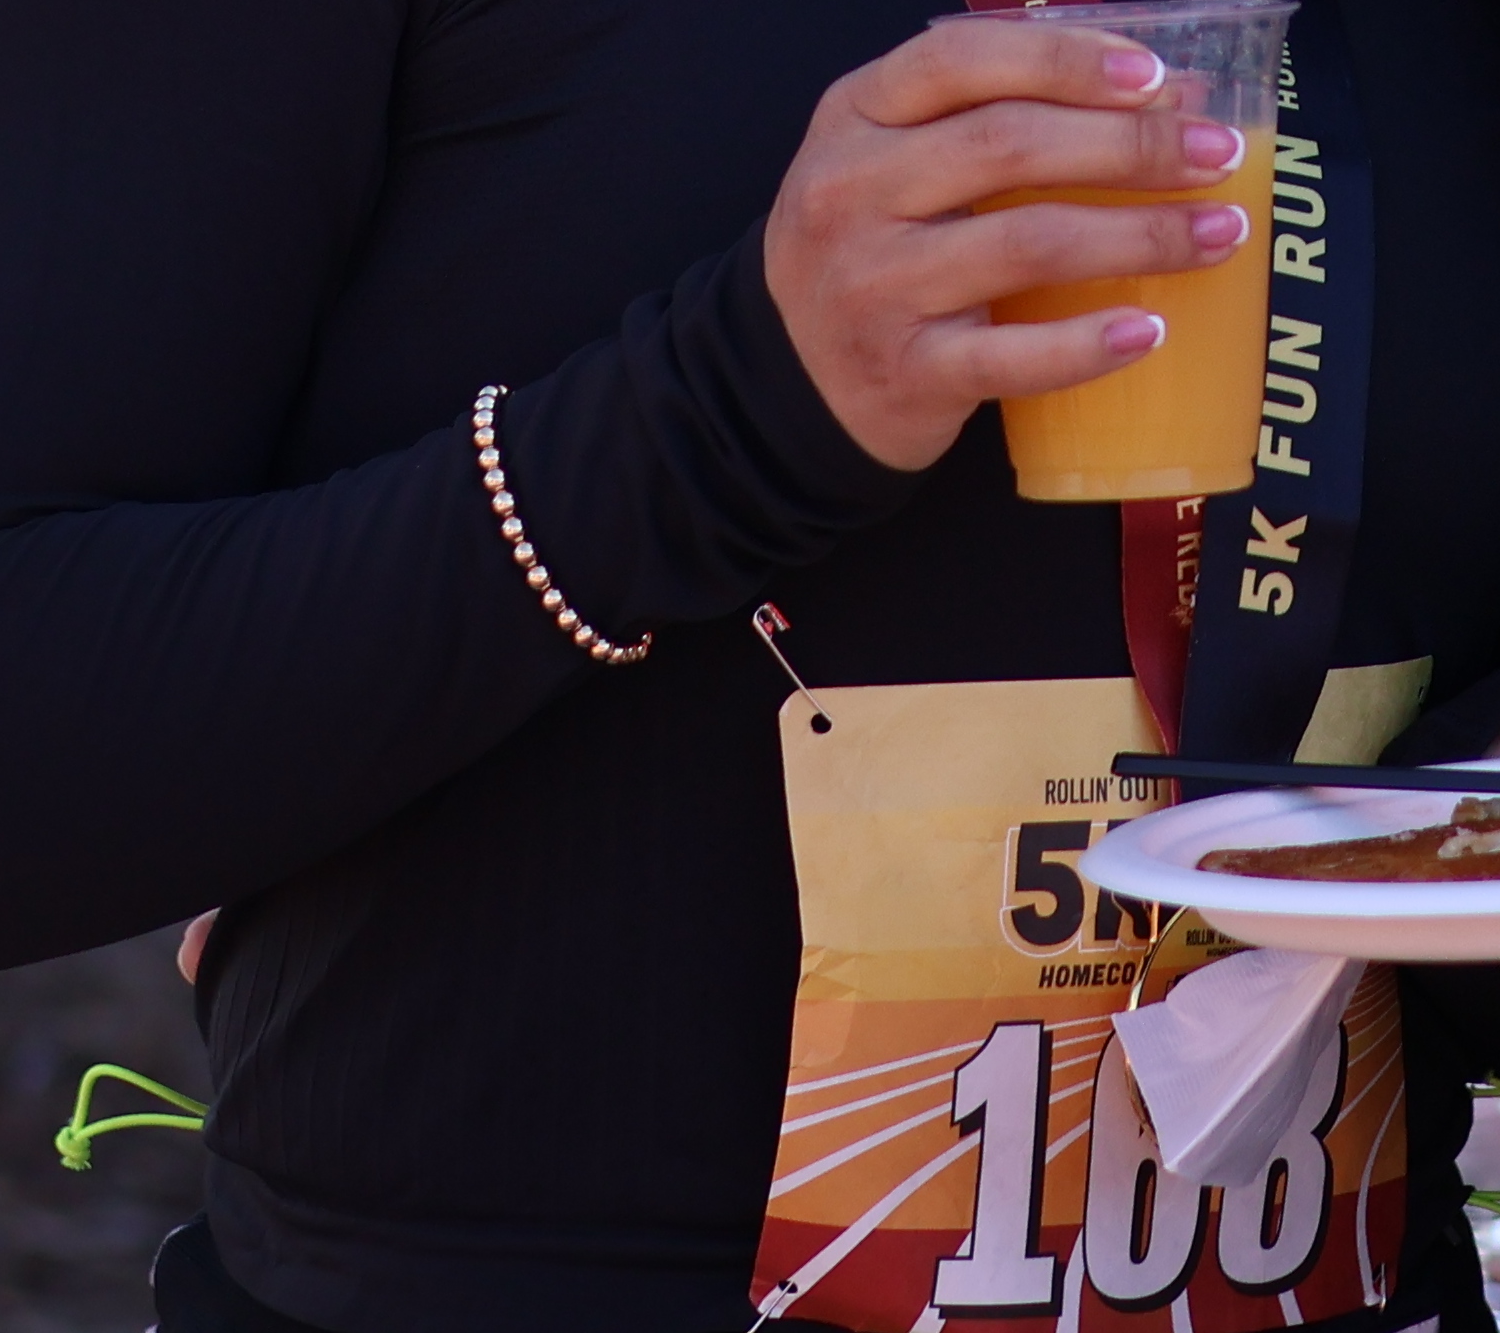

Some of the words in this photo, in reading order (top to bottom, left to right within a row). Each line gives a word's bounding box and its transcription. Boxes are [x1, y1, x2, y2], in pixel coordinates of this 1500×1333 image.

[1272, 133, 1327, 283] RUN
[1257, 314, 1323, 476] FUN
[1238, 505, 1309, 616] 5K
[1045, 776, 1114, 805] ROLLIN'
[1038, 961, 1137, 988] HOMECO
